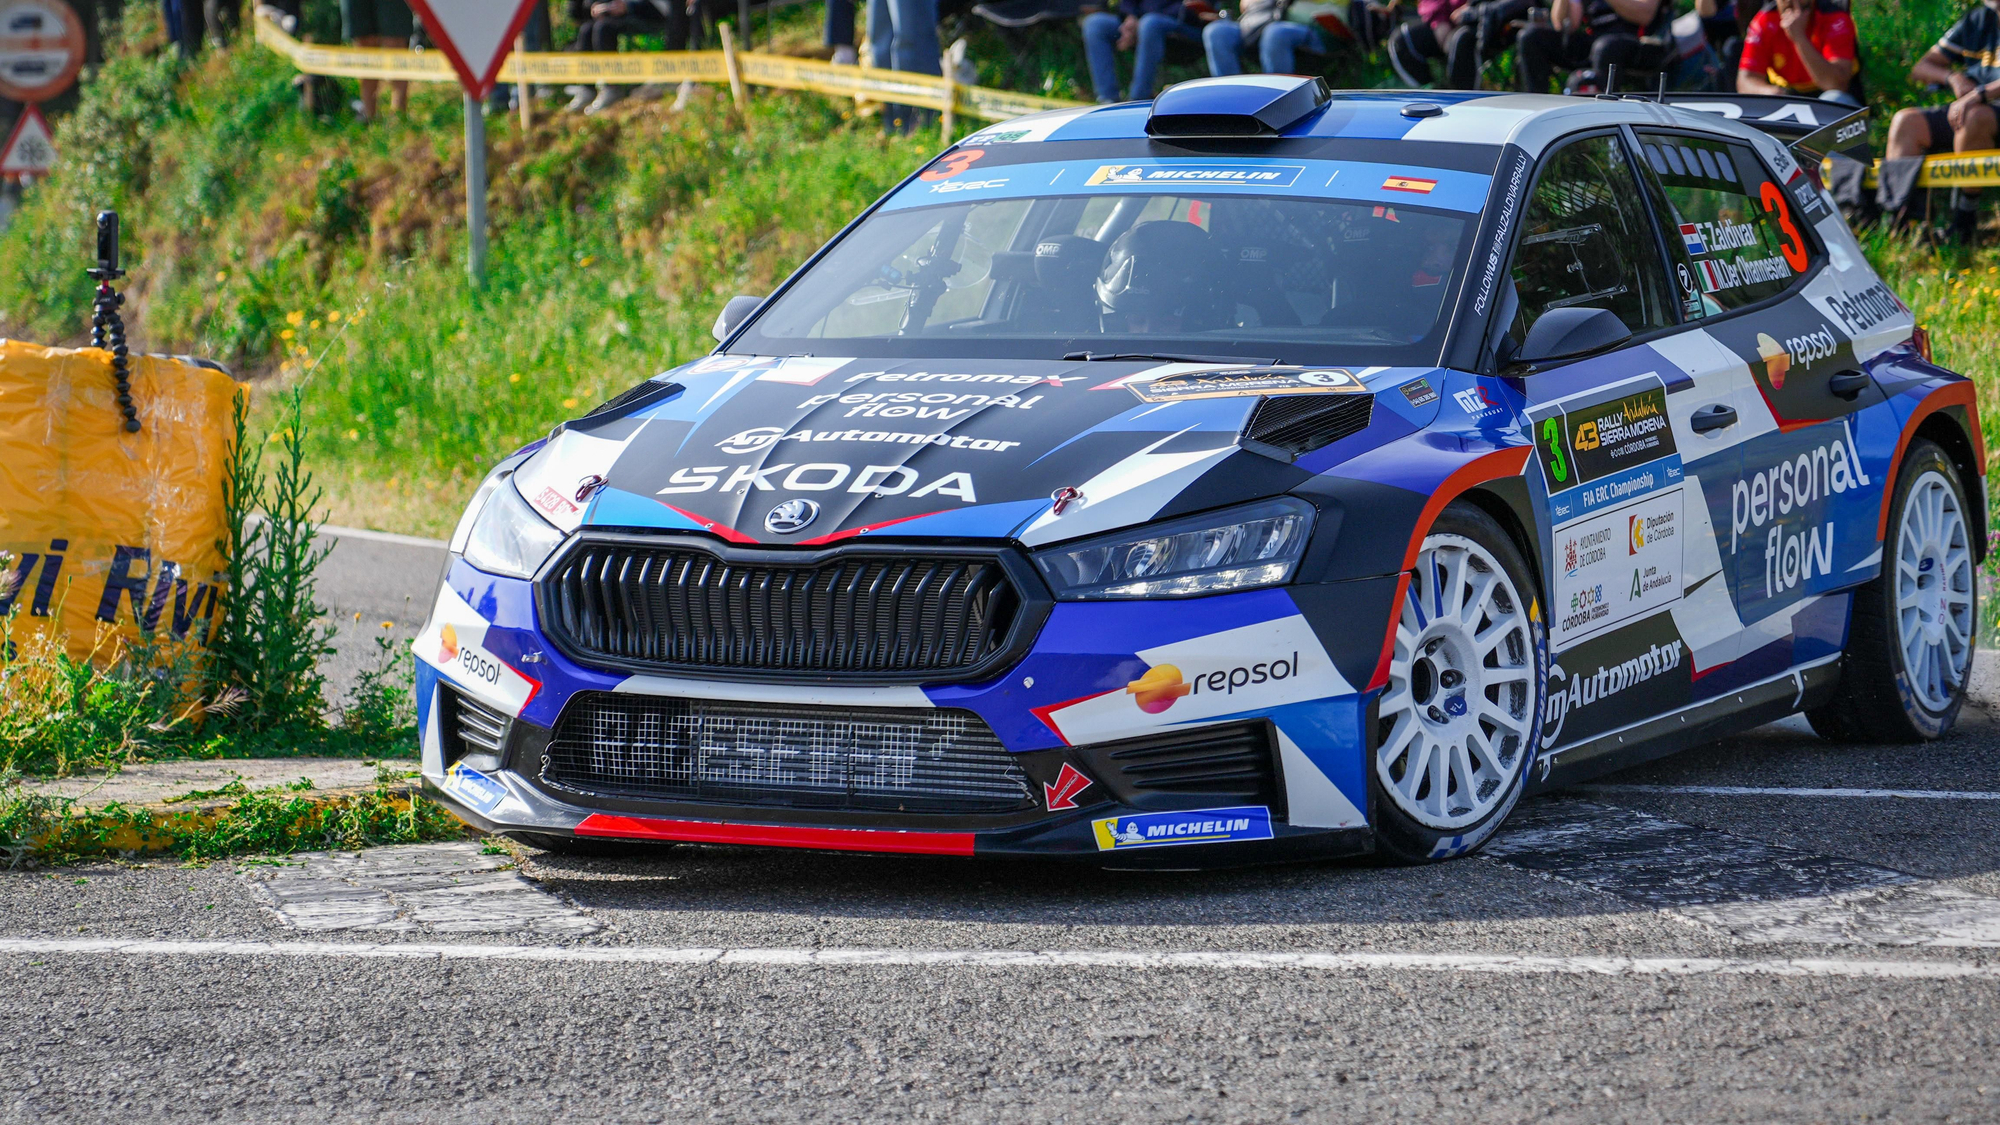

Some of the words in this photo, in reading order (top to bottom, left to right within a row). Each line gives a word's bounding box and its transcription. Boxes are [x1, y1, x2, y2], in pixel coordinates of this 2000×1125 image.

[1836, 119, 1867, 143] SKODA
[919, 149, 985, 182] 3
[1147, 170, 1281, 180] MICHELIN
[1931, 158, 1978, 179] ZONA
[1760, 181, 1808, 273] 3
[1035, 243, 1061, 257] OMP
[1240, 248, 1268, 261] OMP
[1786, 324, 1837, 370] repsol
[1313, 373, 1335, 383] 3
[796, 392, 1044, 410] personal
[843, 405, 970, 420] flow
[1472, 408, 1504, 420] PARAGUAY
[1597, 411, 1623, 432] RALLY
[1599, 426, 1632, 447] SIERRA
[1630, 415, 1667, 438] MORENA
[780, 429, 1021, 452] Automotor
[1543, 417, 1568, 483] 3
[1574, 420, 1600, 452] 43
[657, 463, 977, 503] SKODA
[1582, 491, 1596, 508] FIA
[1595, 485, 1611, 503] ERC
[1610, 471, 1655, 497] Championship
[1731, 420, 1871, 555] personal
[1765, 521, 1834, 598] flow
[1562, 609, 1592, 632] CÓRDOBA
[458, 646, 502, 686] repsol
[1193, 651, 1298, 695] repsol
[1565, 639, 1682, 713] Automotor
[1147, 818, 1249, 838] MICHELIN
